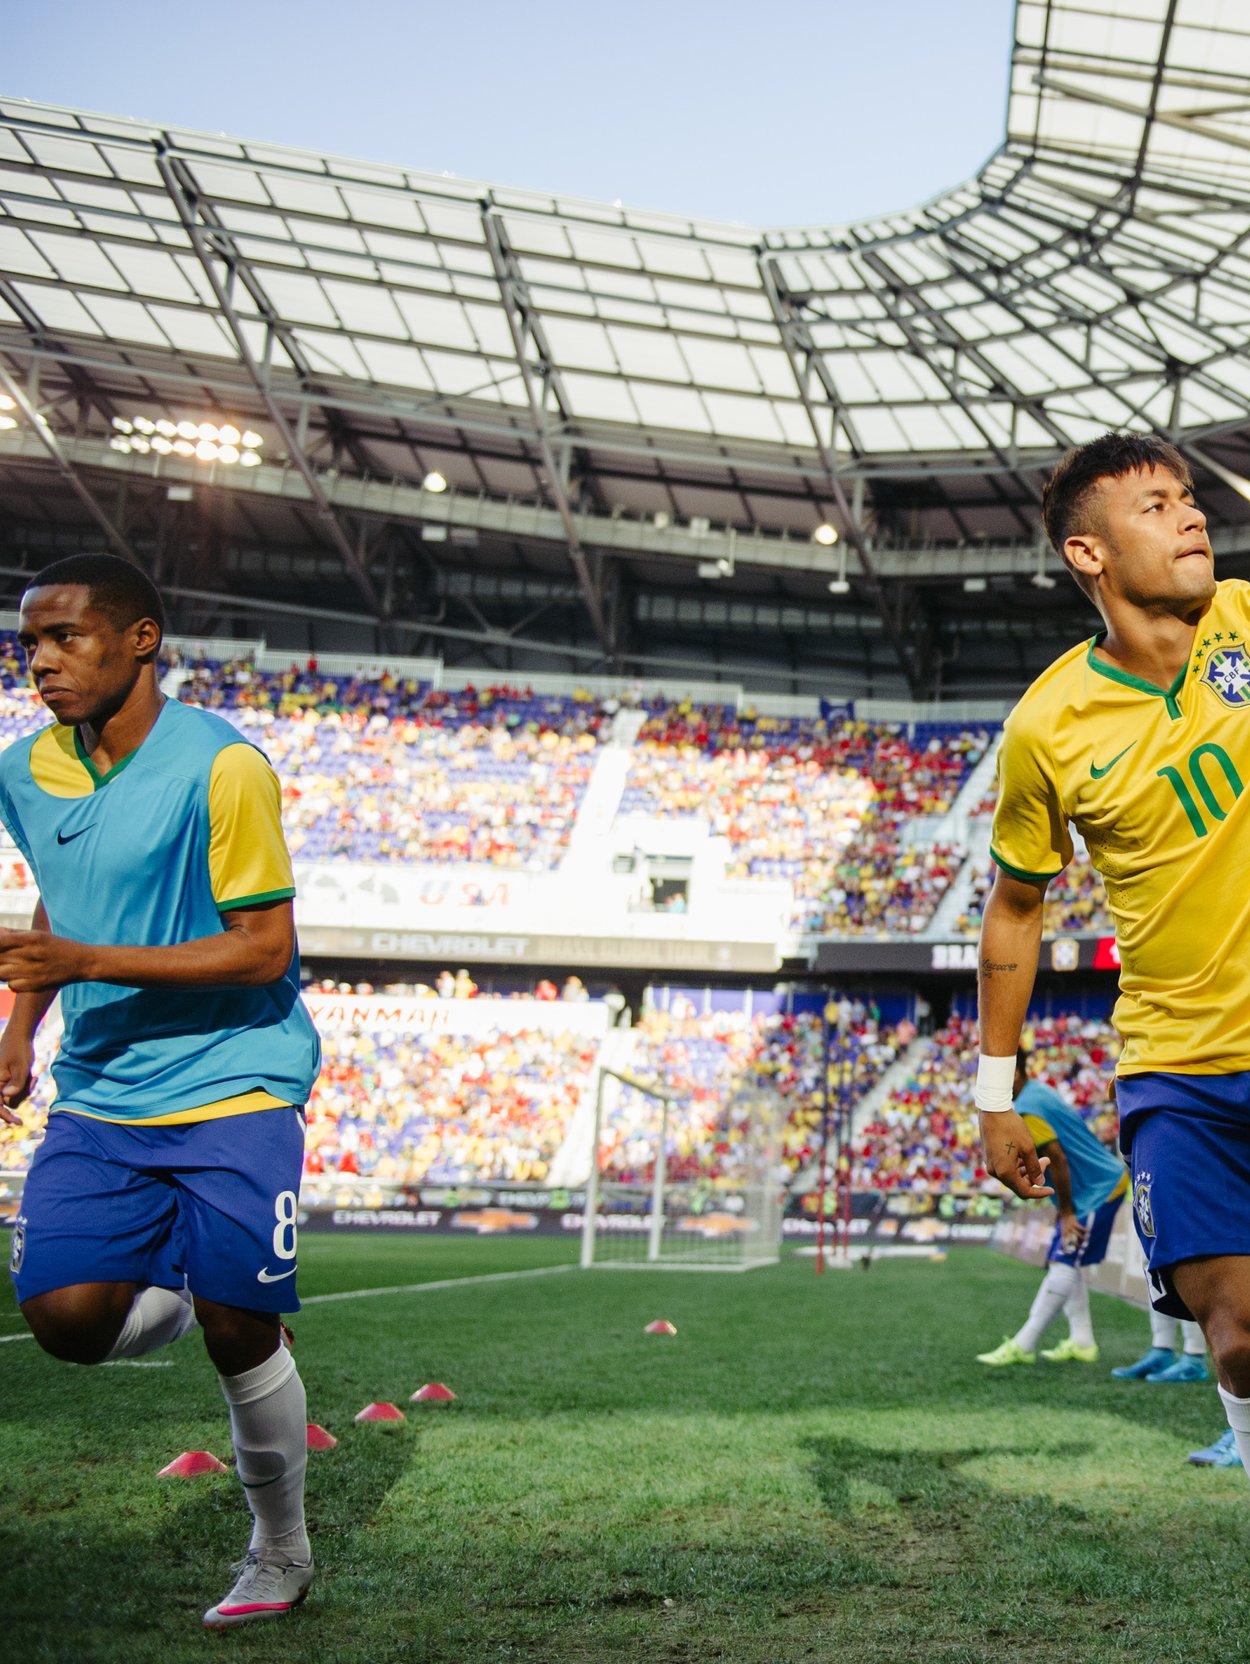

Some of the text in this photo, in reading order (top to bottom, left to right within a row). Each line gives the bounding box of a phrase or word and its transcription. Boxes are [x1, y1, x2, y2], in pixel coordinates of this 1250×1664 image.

[1223, 667, 1241, 684] CBF
[1156, 742, 1245, 838] 10
[371, 932, 530, 958] CHEVROLET
[931, 944, 979, 970] BRA
[273, 1190, 298, 1260] 8
[333, 1210, 442, 1226] CHEVROLET
